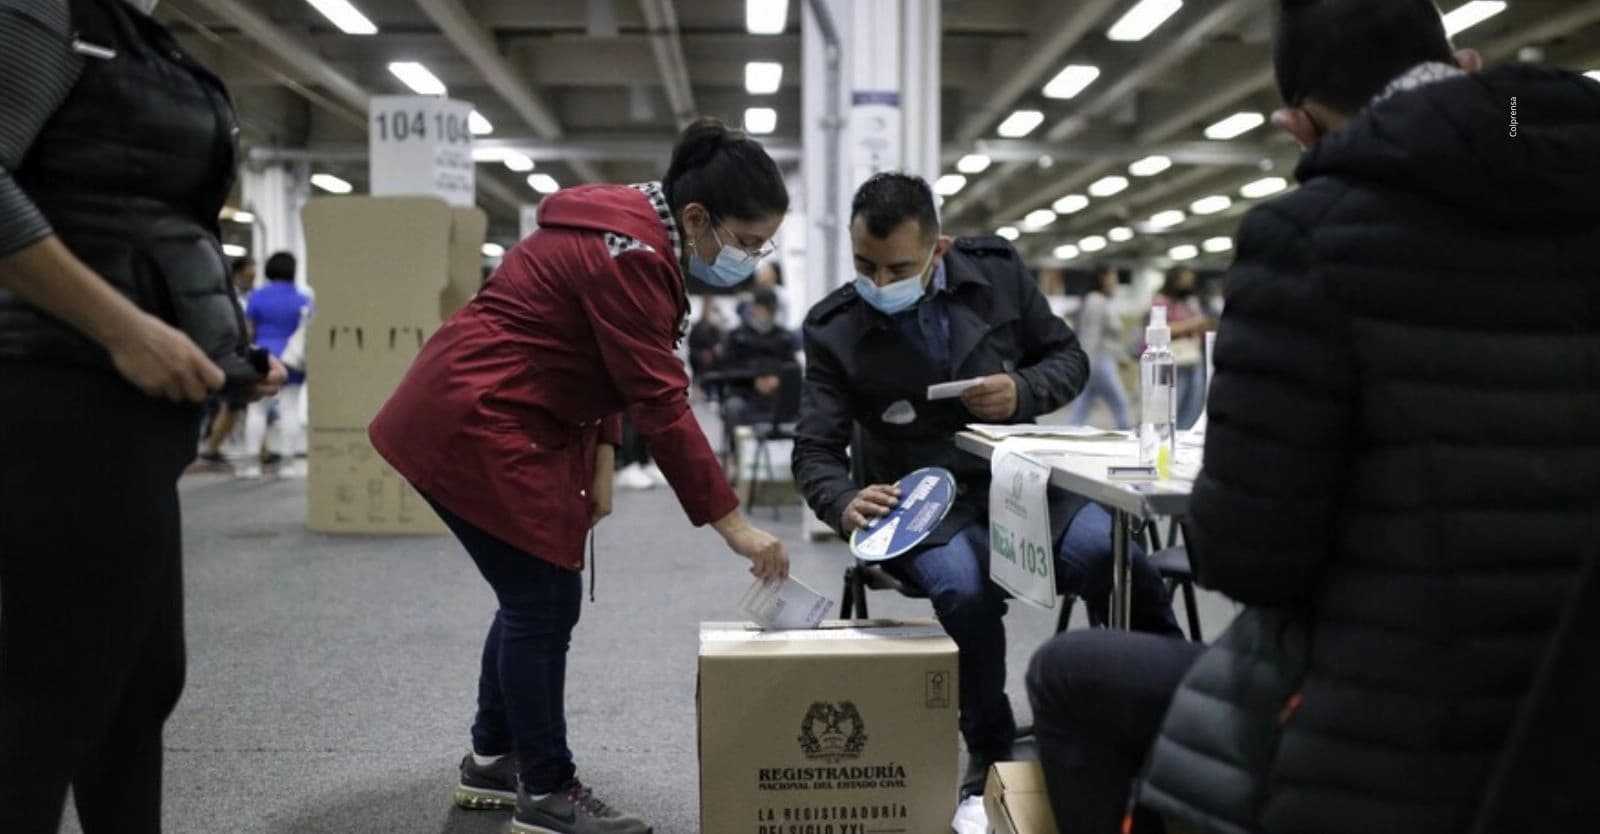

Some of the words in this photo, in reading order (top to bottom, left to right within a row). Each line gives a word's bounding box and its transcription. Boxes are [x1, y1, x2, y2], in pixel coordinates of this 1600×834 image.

[376, 109, 427, 142] 104
[434, 112, 471, 144] 104
[1019, 536, 1048, 577] 103
[759, 763, 906, 781] REGISTRADURÍA
[759, 781, 809, 791] NACIONAL
[814, 781, 833, 790] DEL
[837, 780, 877, 790] ESTADO
[879, 779, 907, 788] CIVIL
[758, 808, 774, 821] LA
[784, 804, 907, 820] REGISTRADURÍA
